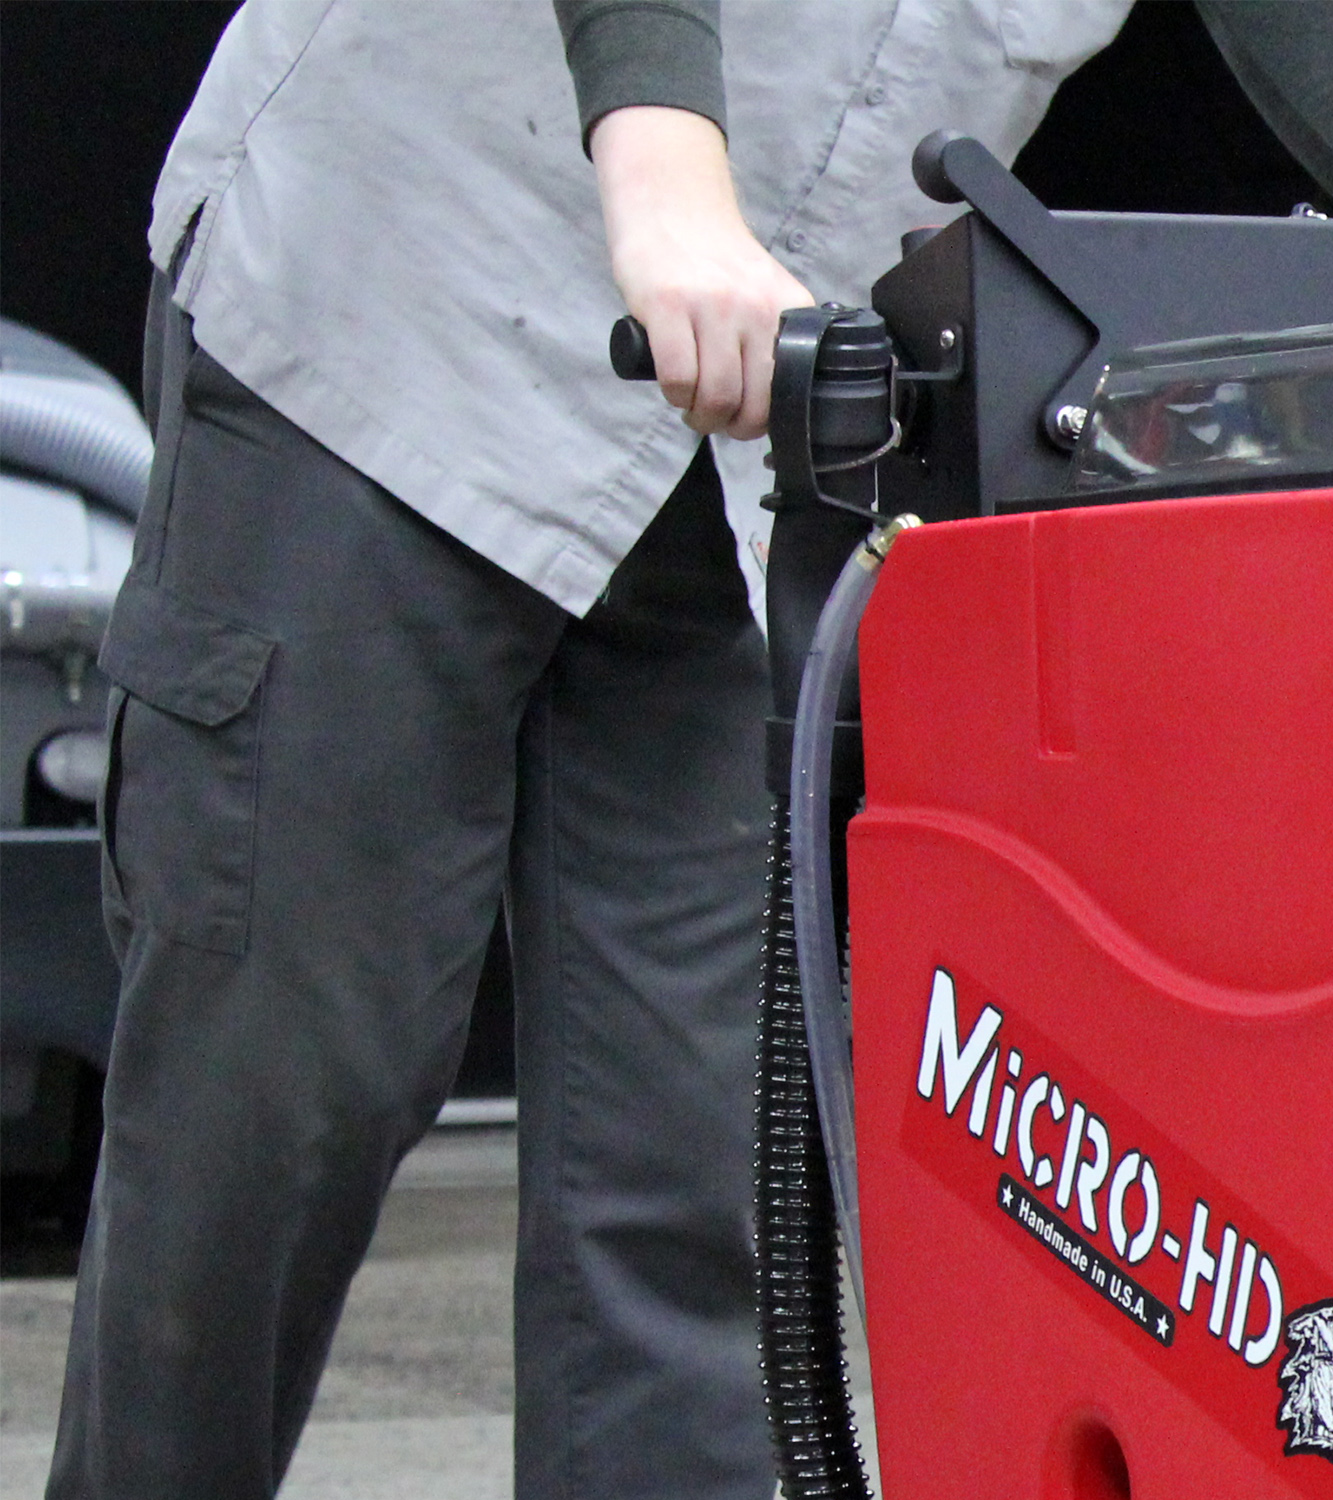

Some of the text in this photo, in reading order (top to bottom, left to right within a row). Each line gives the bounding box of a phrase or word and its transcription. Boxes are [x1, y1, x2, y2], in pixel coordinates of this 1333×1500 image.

[1018, 1197, 1148, 1323] Handmade in U.S.A.
